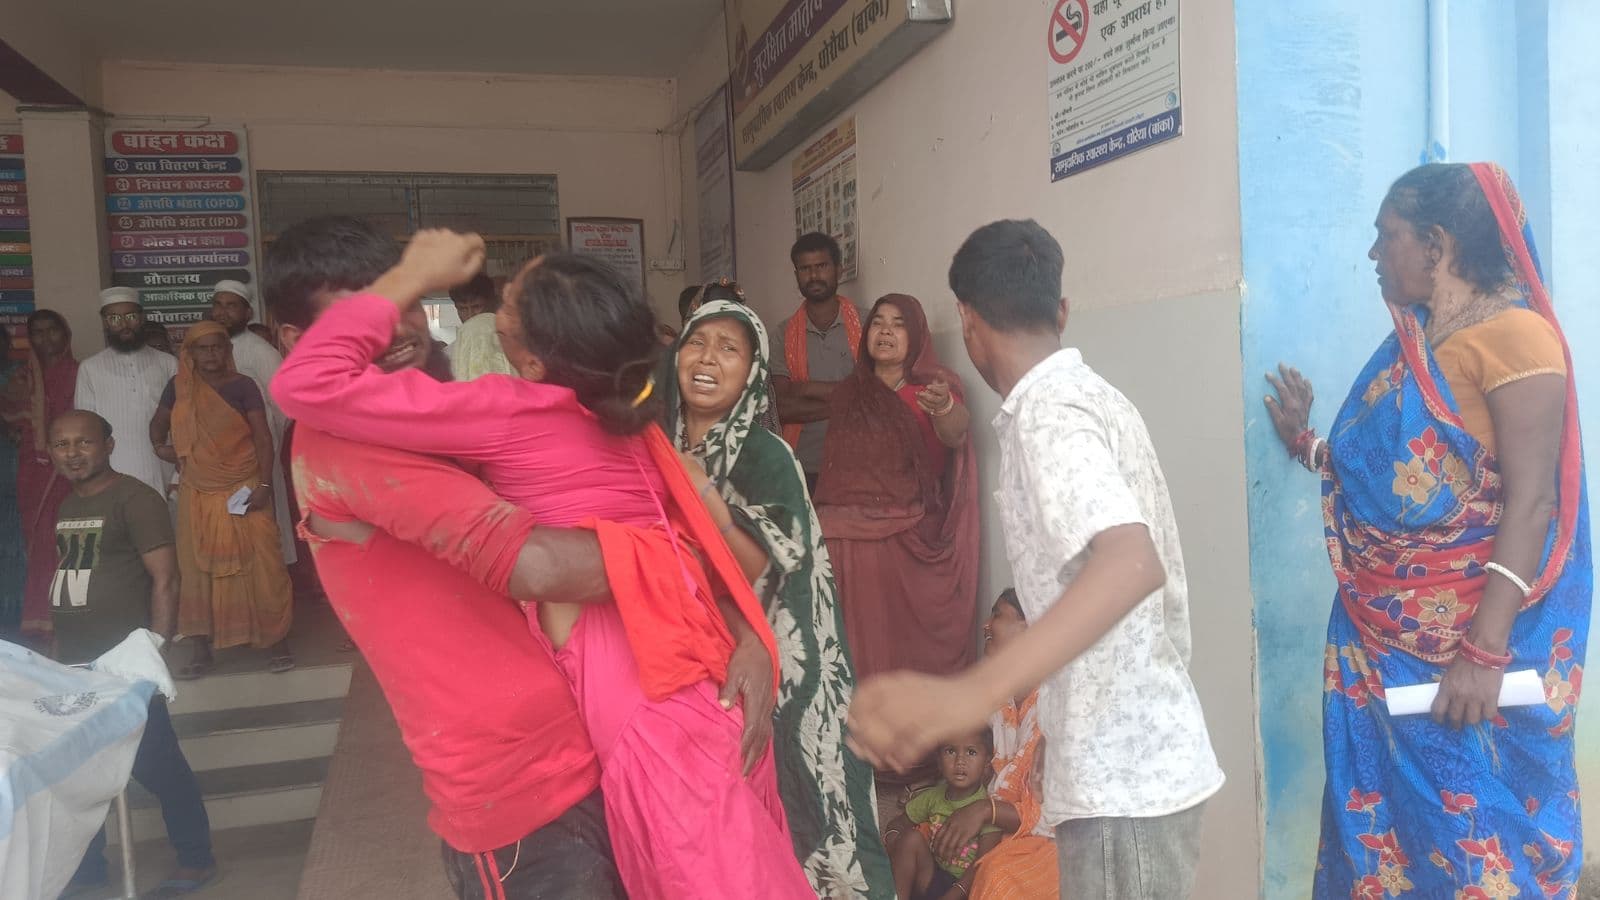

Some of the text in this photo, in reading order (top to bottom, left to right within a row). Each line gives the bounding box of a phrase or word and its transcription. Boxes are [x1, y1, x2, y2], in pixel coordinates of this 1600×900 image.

[1100, 20, 1118, 41] एक
[1120, 0, 1152, 29] अपराध
[754, 31, 787, 88] सुरक्षित
[181, 134, 227, 148] कक्ष
[1055, 152, 1085, 174] सामुदायिक
[1085, 143, 1108, 161] स्वास्थ्य
[1148, 115, 1174, 139] (बांका)
[135, 161, 156, 171] दवा
[160, 159, 200, 171] वितरण
[136, 179, 181, 190] निबंधन
[143, 255, 186, 265] स्थापना
[188, 251, 240, 264] कार्यालय
[144, 272, 200, 284] शौचालय
[146, 311, 203, 322] शौचालय
